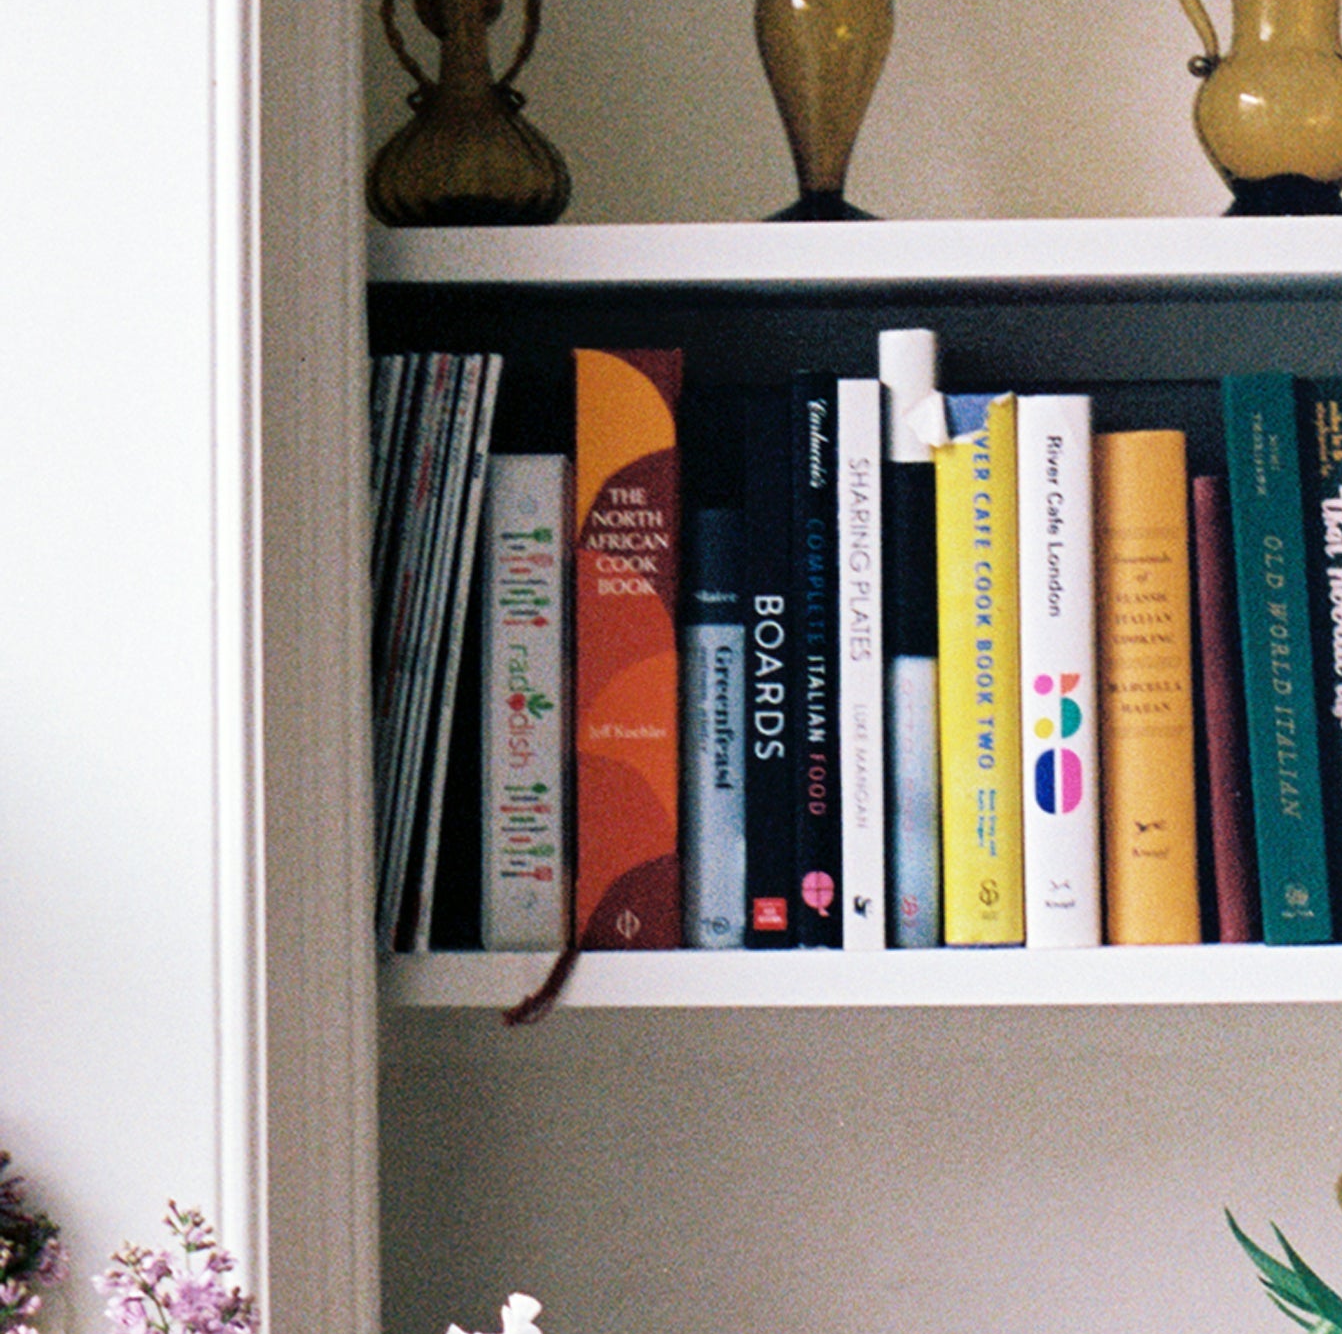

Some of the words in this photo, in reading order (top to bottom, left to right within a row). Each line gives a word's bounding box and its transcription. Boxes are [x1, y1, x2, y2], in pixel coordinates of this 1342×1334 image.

[1045, 434, 1062, 484] River
[592, 510, 662, 527] NORTH
[608, 488, 647, 505] THE
[848, 458, 873, 574] SHARING
[973, 493, 991, 549] CAFE
[1046, 492, 1063, 536] Cafe
[587, 533, 669, 549] AFRICAN
[596, 556, 658, 572] COOK
[1262, 535, 1285, 589] OLD
[597, 578, 656, 595] BOOK
[807, 518, 826, 644] COMPLETE
[974, 562, 992, 627] COOK
[1047, 542, 1063, 617] London
[850, 581, 873, 662] PLATES
[1266, 600, 1292, 695] WORLD
[753, 594, 785, 761] BOARDS
[807, 655, 826, 743] ITALIAN
[975, 640, 993, 705] BOOK
[712, 645, 734, 790] Greenfeast
[977, 717, 995, 770] TWO
[808, 753, 826, 817] FOOD
[1274, 703, 1302, 821] ITALIAN
